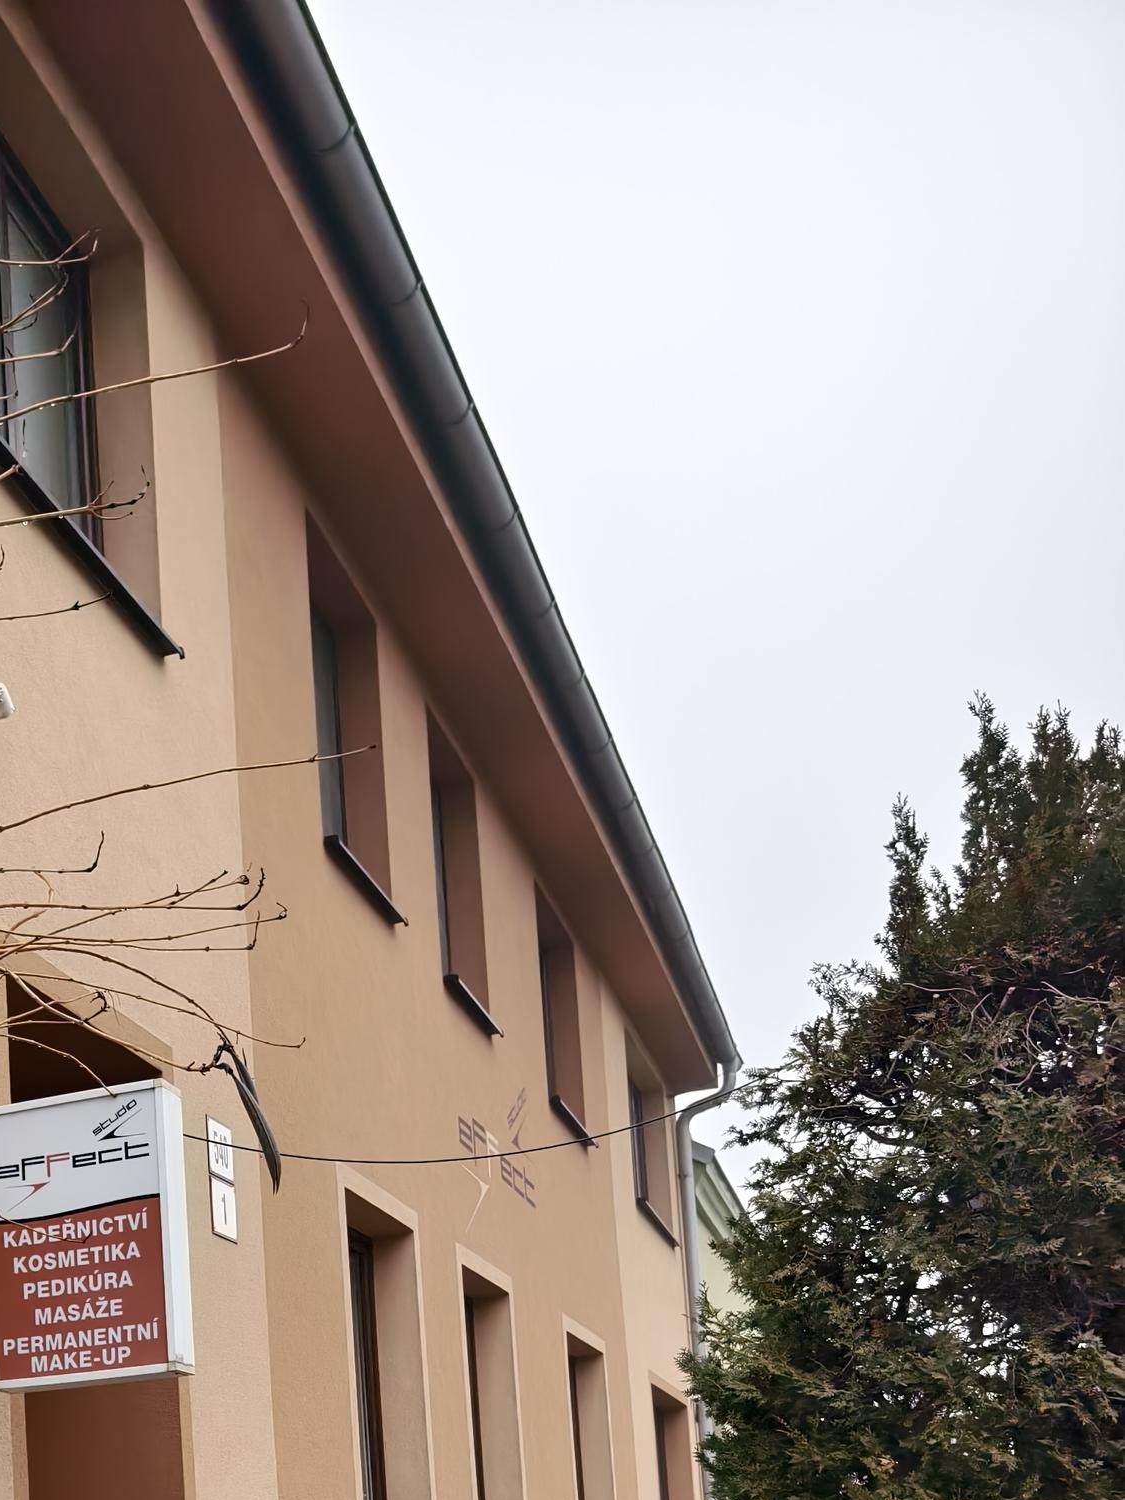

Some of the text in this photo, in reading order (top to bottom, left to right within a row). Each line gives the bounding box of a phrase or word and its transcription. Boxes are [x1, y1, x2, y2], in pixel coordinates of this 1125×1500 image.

[213, 1130, 229, 1169] 540
[221, 1193, 227, 1225] 1
[3, 1207, 149, 1248] KADEŘNICTVÍ
[13, 1240, 141, 1274] KOSMETIKA
[23, 1270, 134, 1300] PEDIKÚRA
[34, 1299, 124, 1326] MASÁŽE
[3, 1317, 159, 1356] PERMANENTNÍ
[31, 1346, 132, 1374] MAKE-UP
